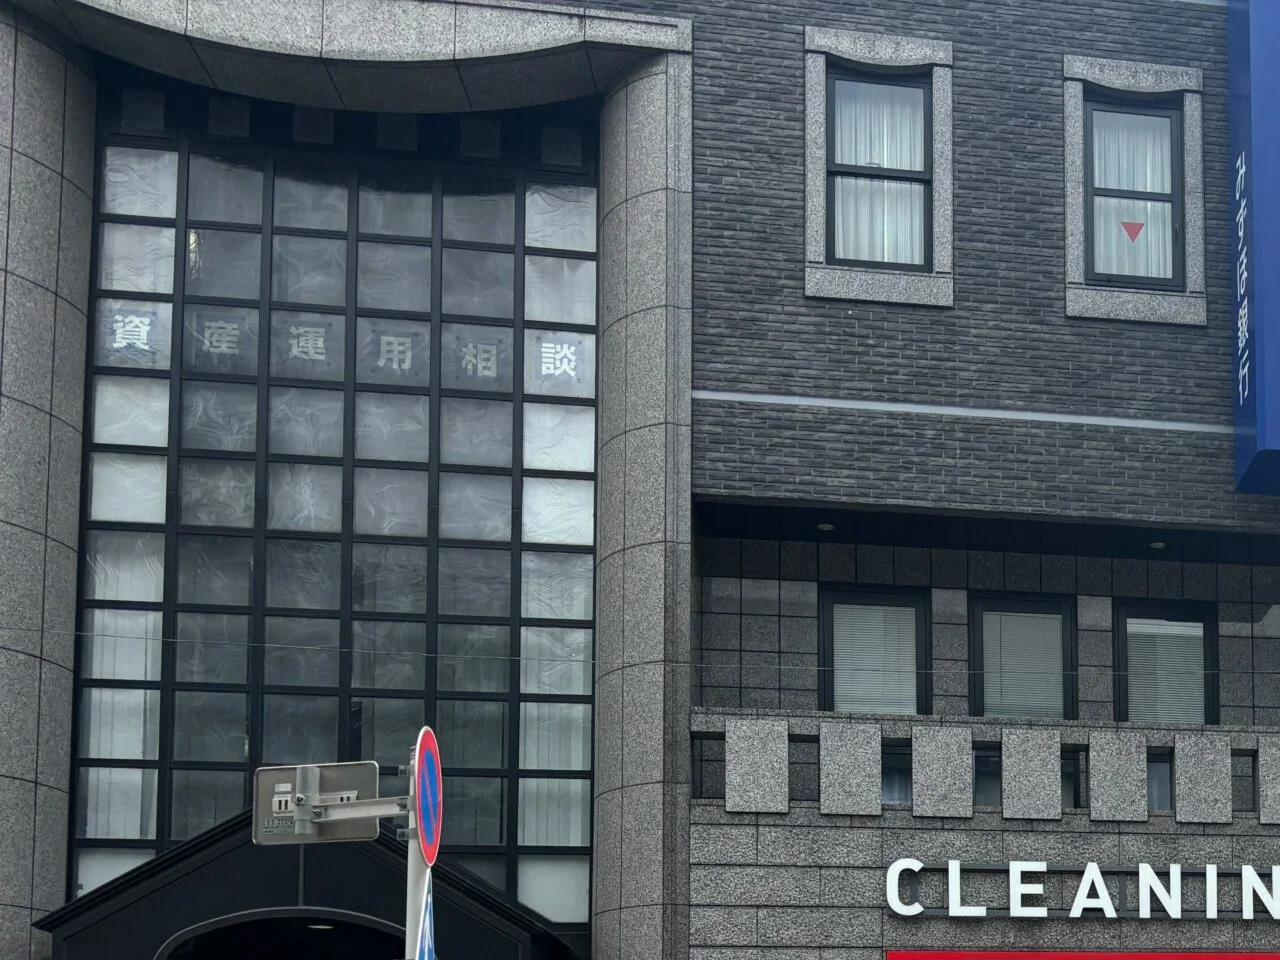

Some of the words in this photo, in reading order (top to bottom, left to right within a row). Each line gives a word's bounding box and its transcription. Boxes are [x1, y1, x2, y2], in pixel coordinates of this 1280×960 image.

[112, 314, 577, 378] 資産運用相談
[1235, 151, 1250, 406] みずほ銀行
